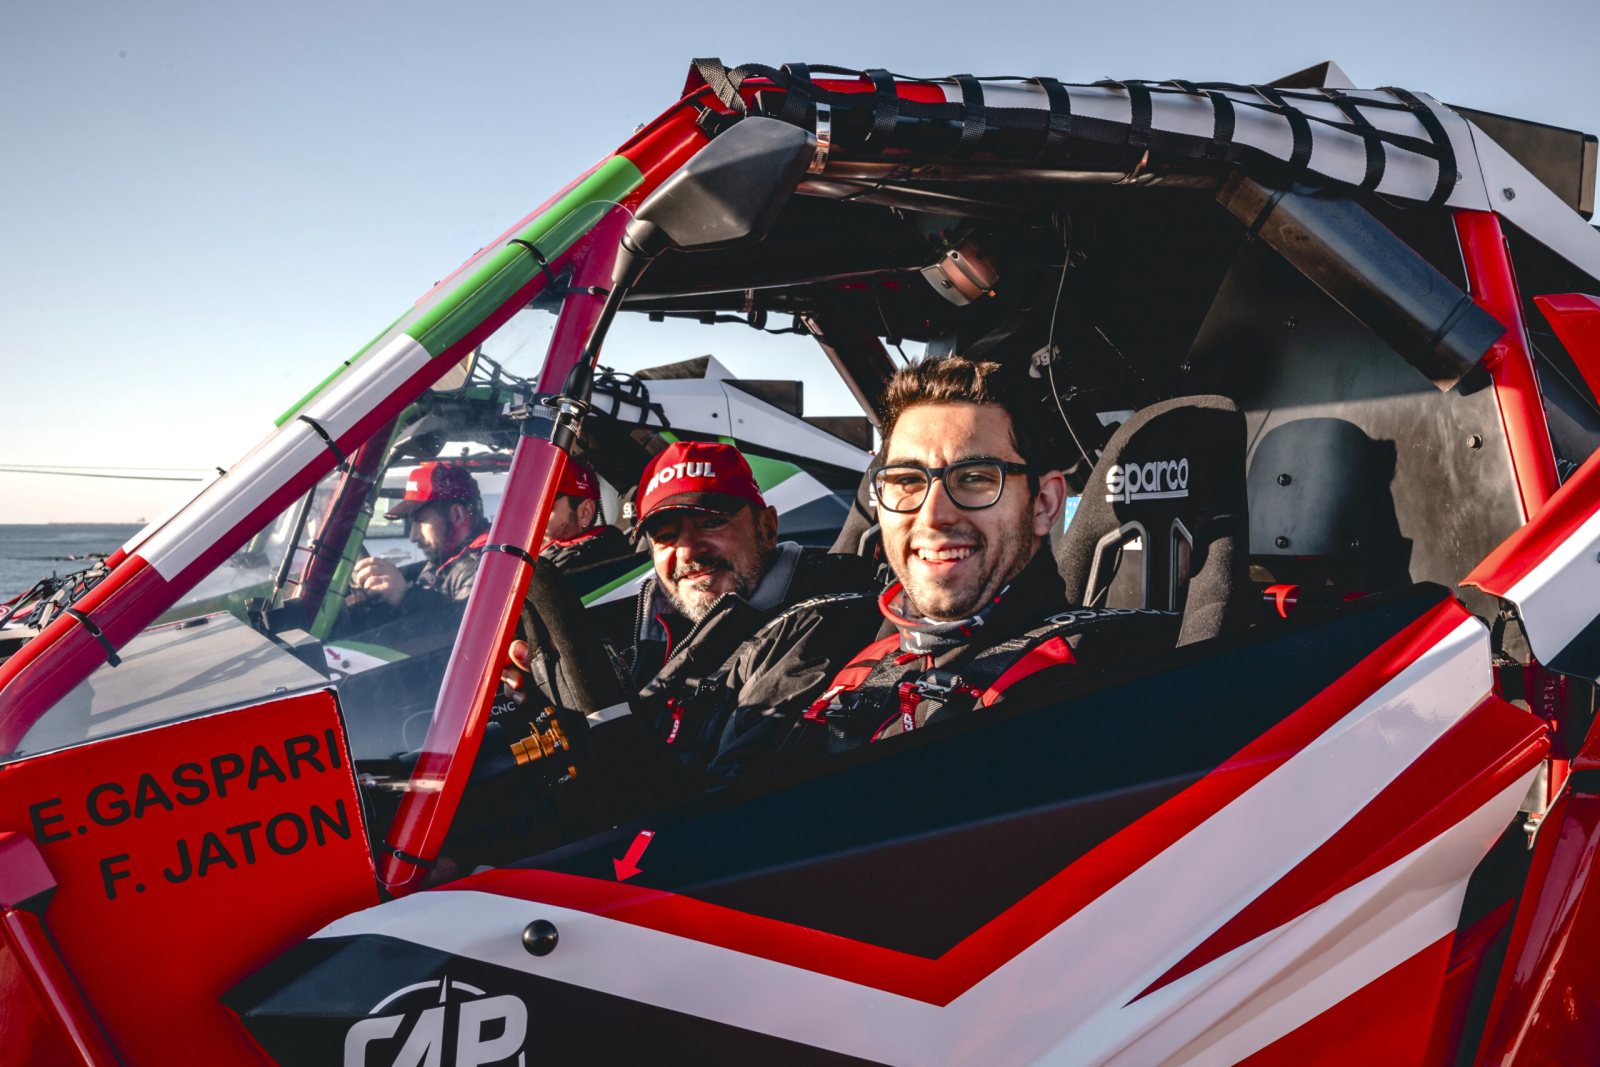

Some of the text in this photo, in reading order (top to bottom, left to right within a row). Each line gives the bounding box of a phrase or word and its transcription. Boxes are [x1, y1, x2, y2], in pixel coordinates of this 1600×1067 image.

[645, 461, 716, 497] MOTUL
[1106, 458, 1189, 504] sparco
[28, 727, 341, 845] E.GASPARI
[100, 799, 351, 901] F. JATON
